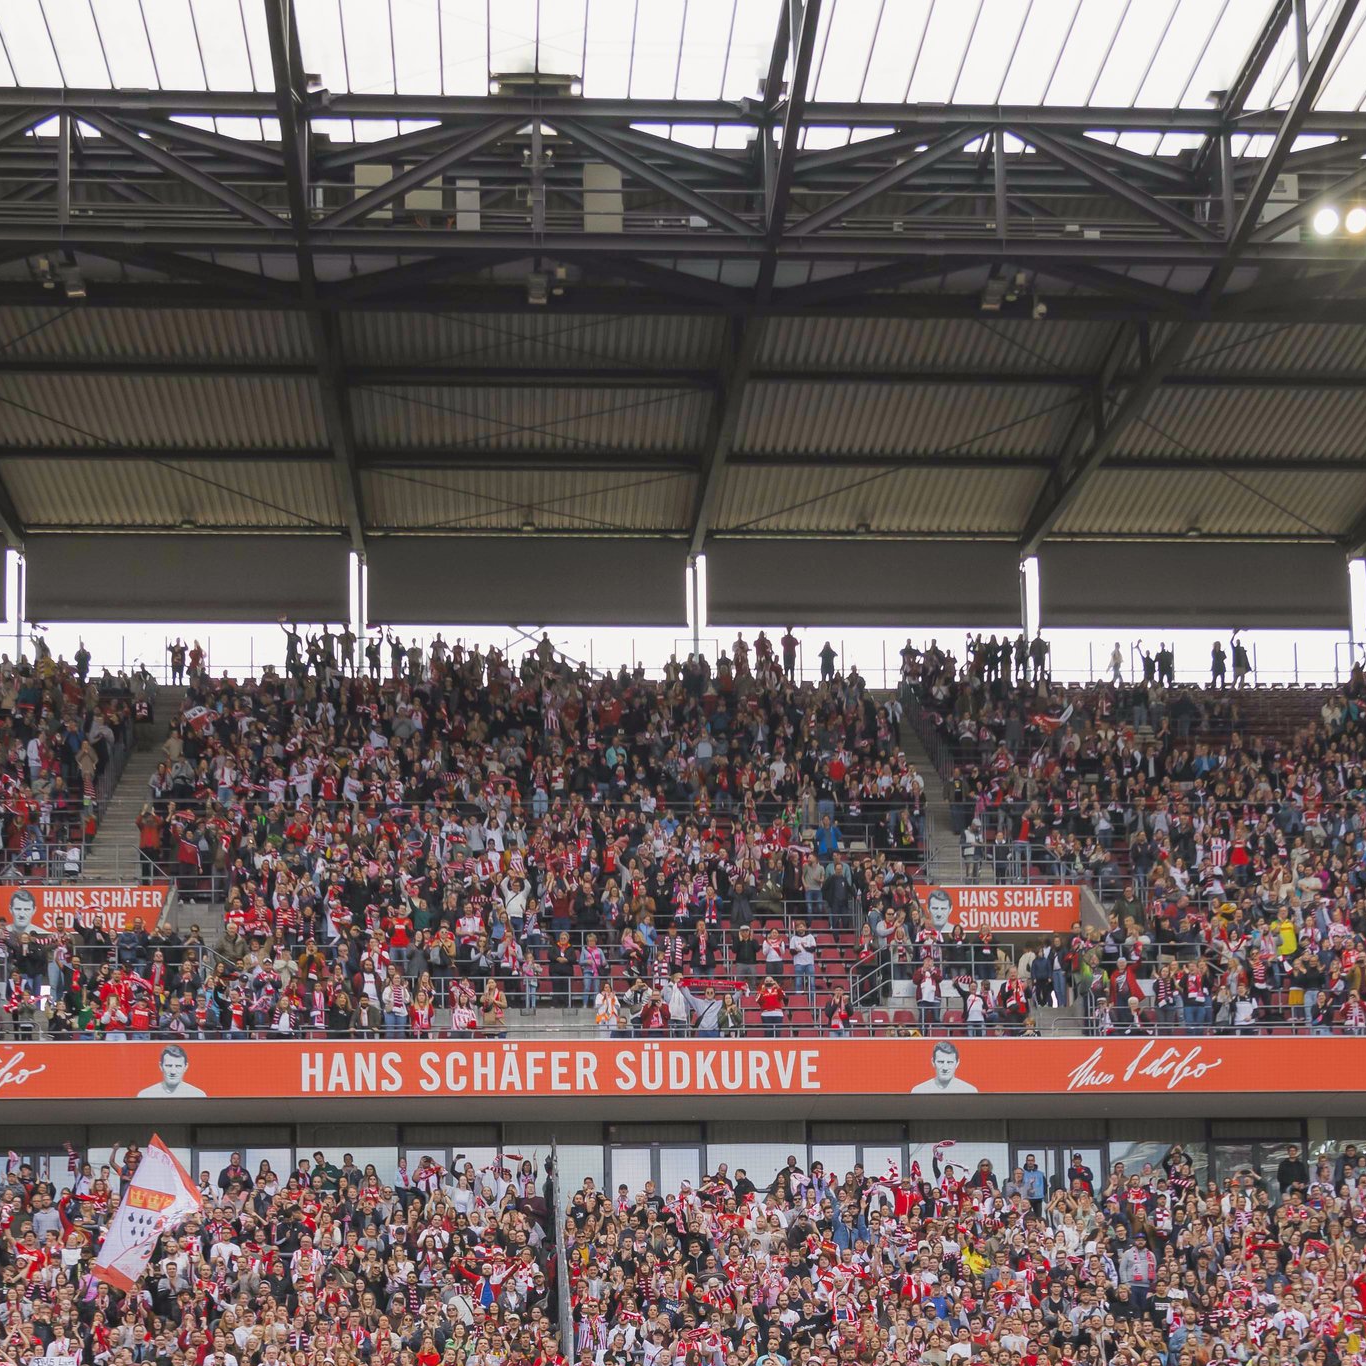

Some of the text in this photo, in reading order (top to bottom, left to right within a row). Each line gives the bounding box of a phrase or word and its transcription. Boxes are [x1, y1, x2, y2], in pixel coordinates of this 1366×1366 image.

[43, 888, 163, 907] HANS SCHÄFER
[958, 888, 1074, 907] HANS SCHÄFER
[959, 909, 1040, 928] SÜDKURVE
[300, 1043, 821, 1092] HANS SCHÄFER SÜDKURVE
